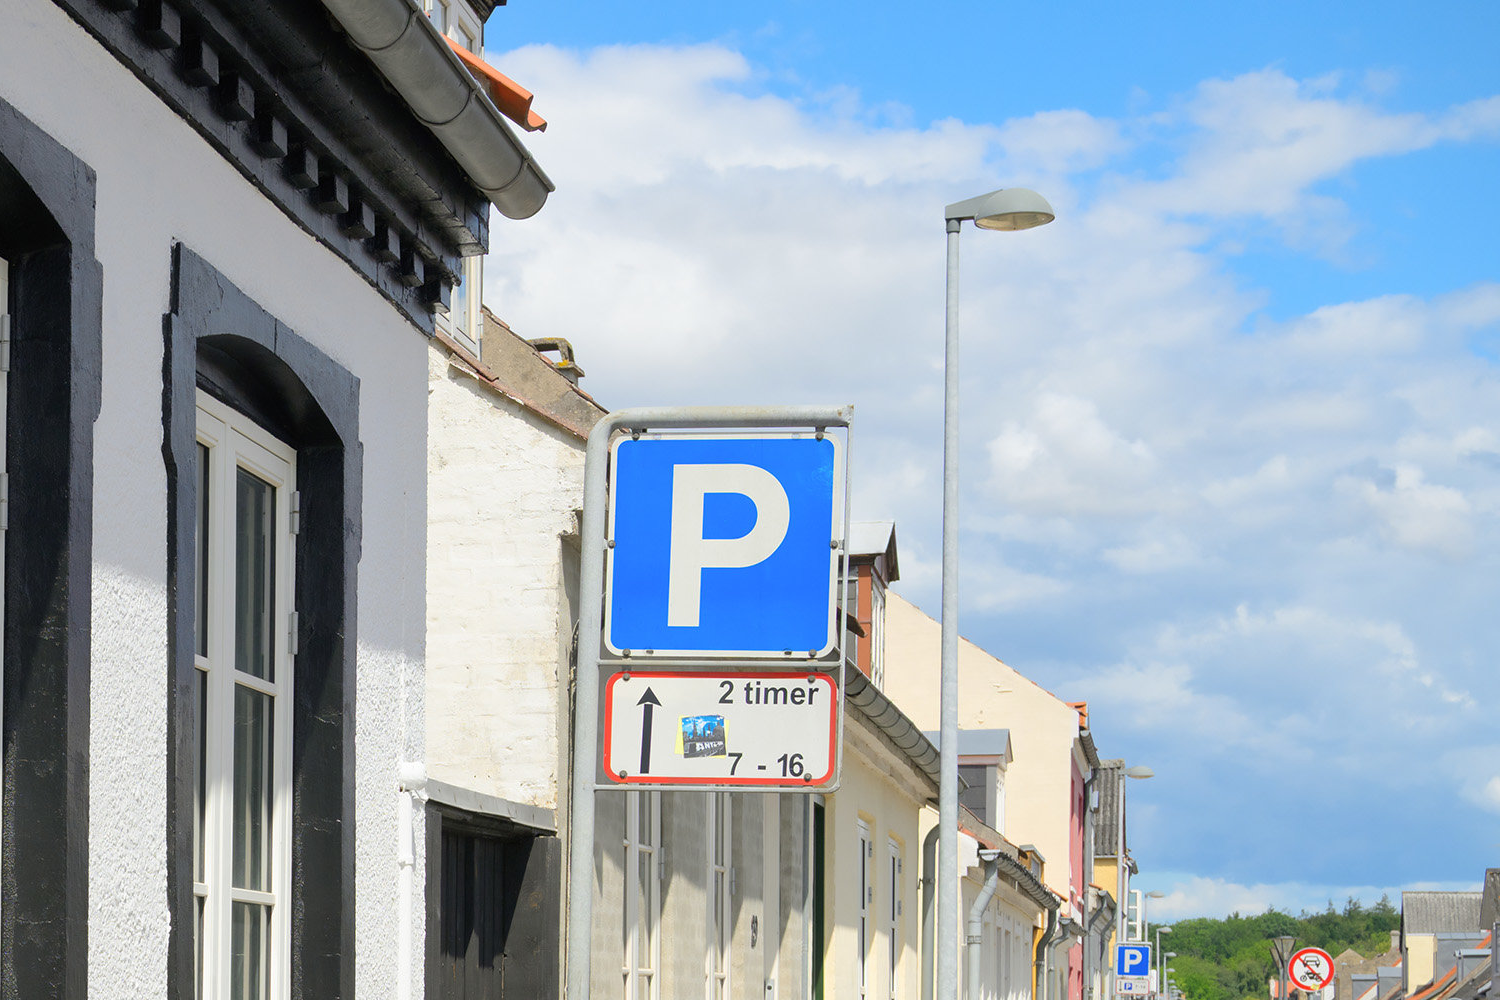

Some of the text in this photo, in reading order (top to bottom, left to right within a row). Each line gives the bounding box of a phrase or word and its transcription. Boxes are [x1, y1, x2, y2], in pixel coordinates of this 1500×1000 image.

[667, 464, 791, 627] P
[718, 680, 820, 706] 2 timer
[728, 752, 743, 776] 7
[777, 753, 804, 778] 16
[1124, 949, 1143, 973] P
